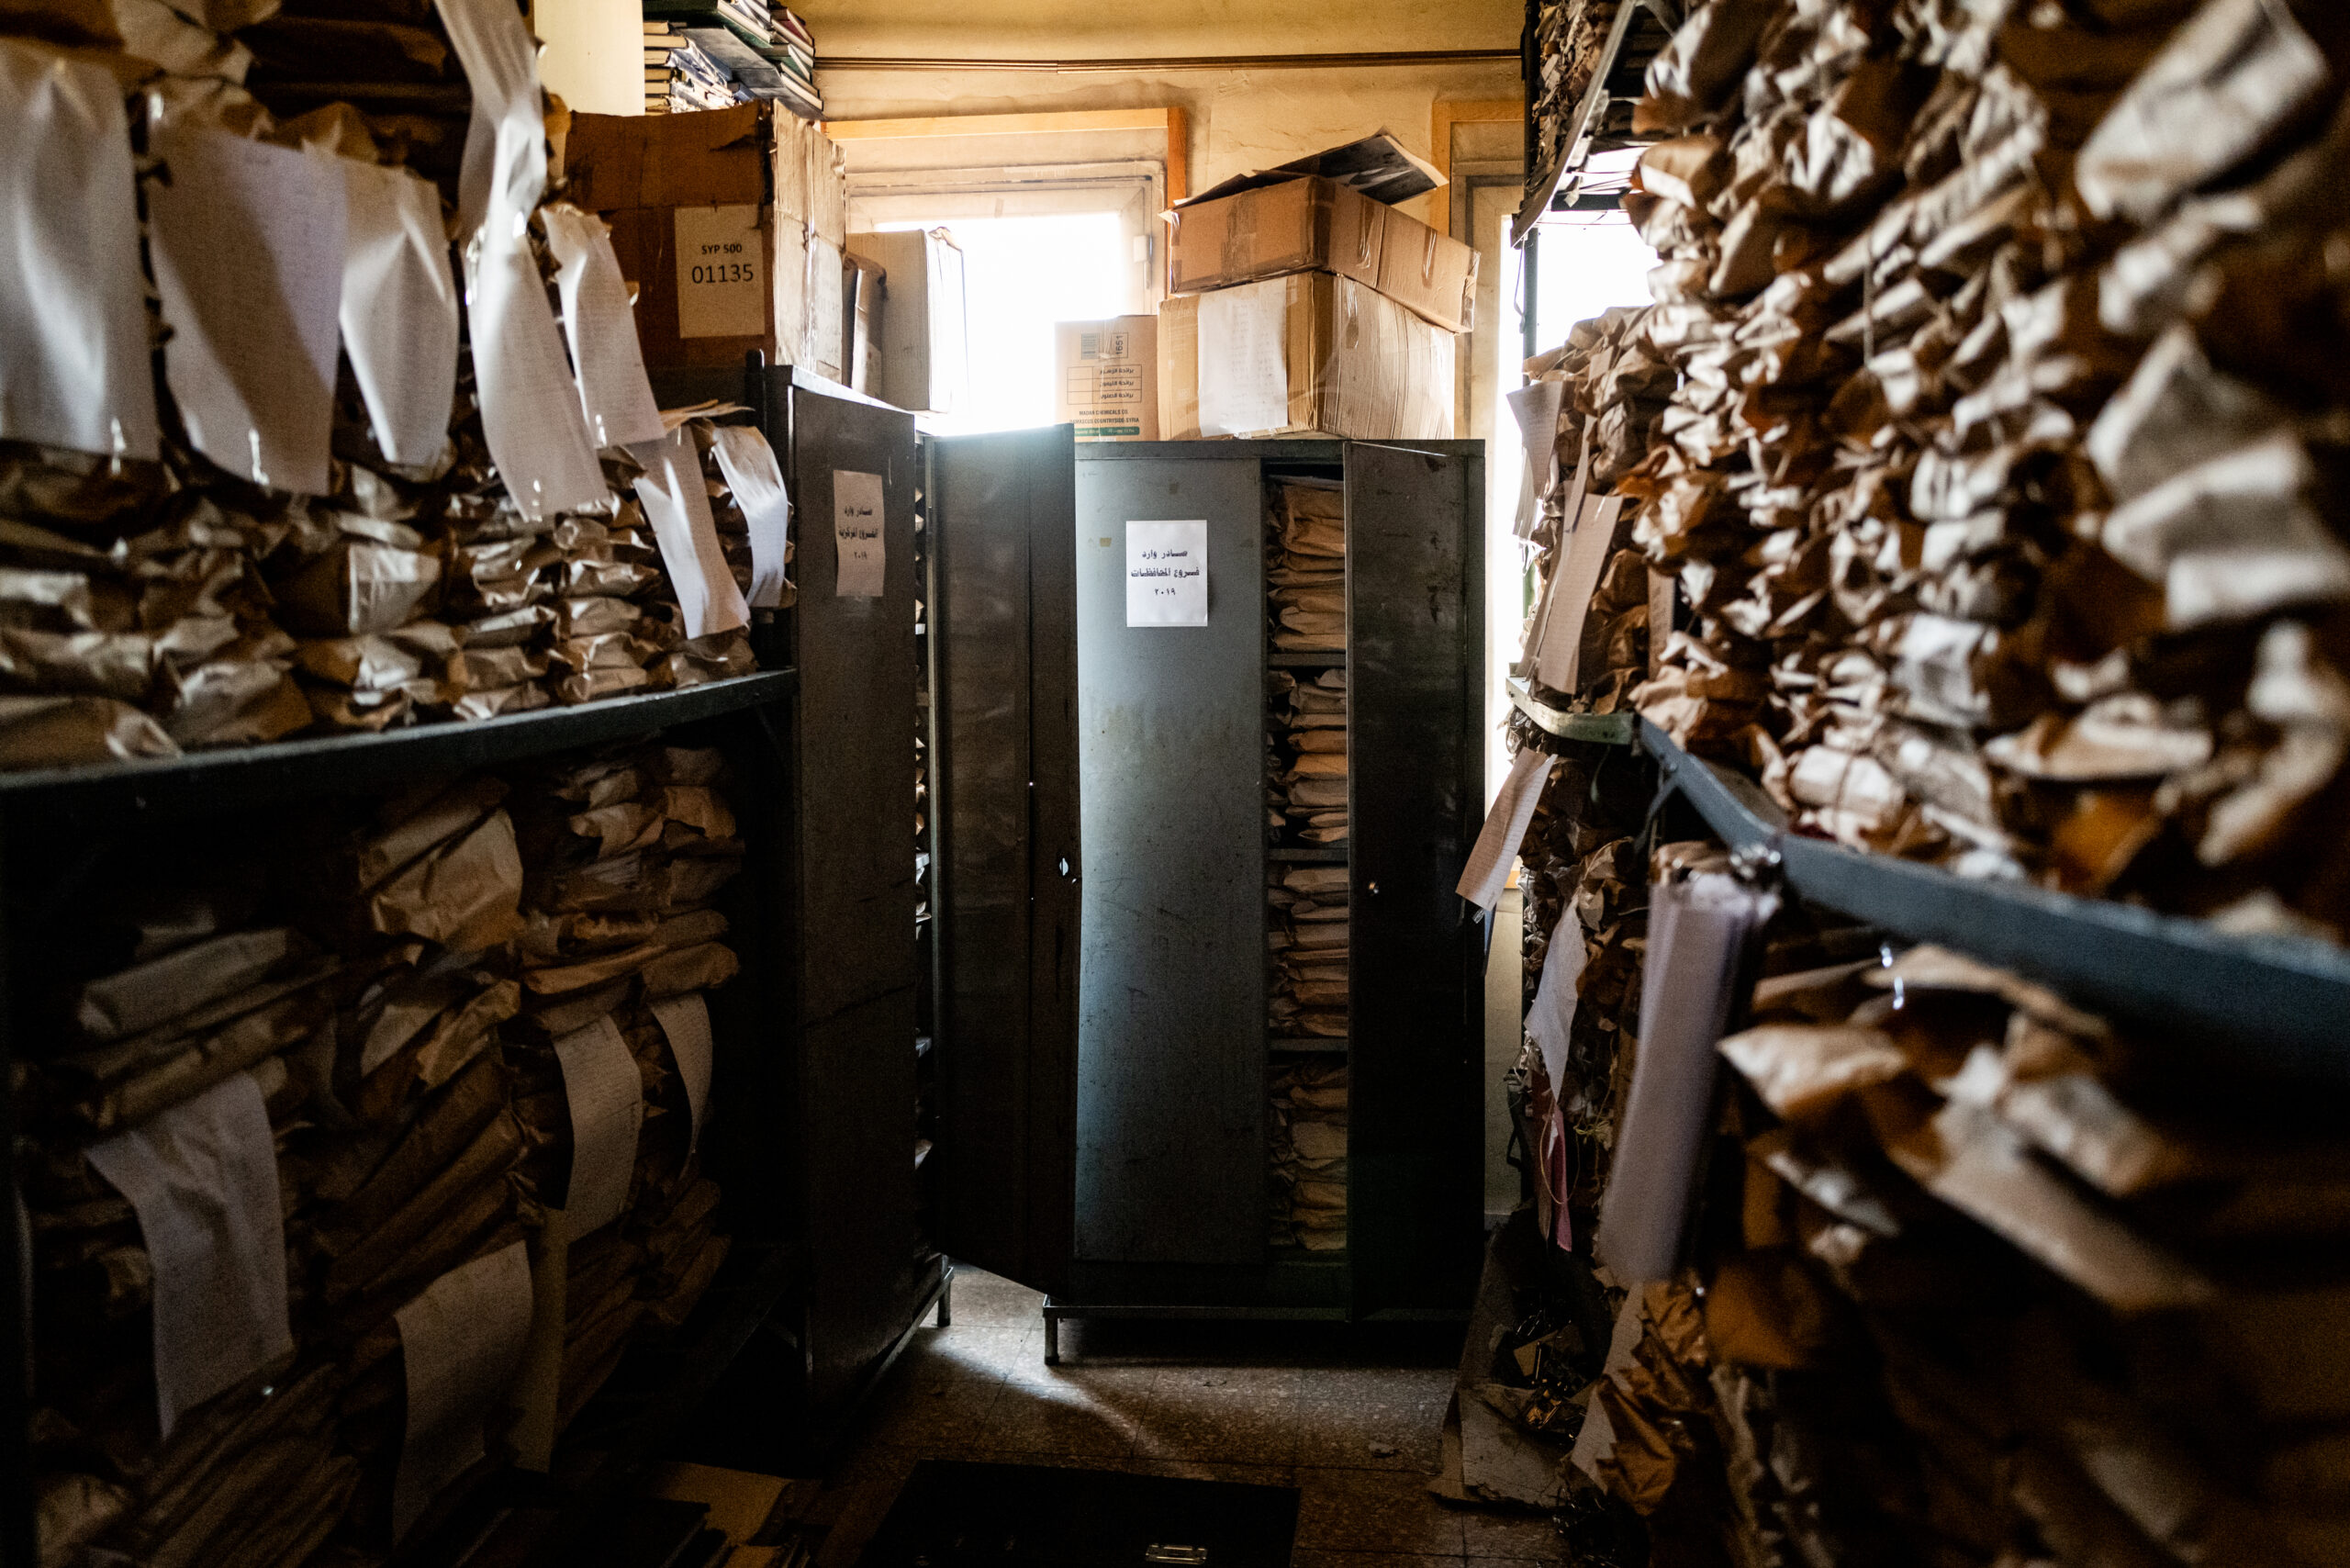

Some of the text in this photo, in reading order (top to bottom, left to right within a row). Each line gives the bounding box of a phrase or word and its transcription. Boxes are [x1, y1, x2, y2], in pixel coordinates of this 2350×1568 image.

[701, 242, 743, 254] SYP 500
[691, 263, 754, 284] 01135
[1141, 549, 1158, 560] وارد
[1131, 566, 1200, 578] فروع المحافظات
[1154, 588, 1176, 596] ٢٠١٩
